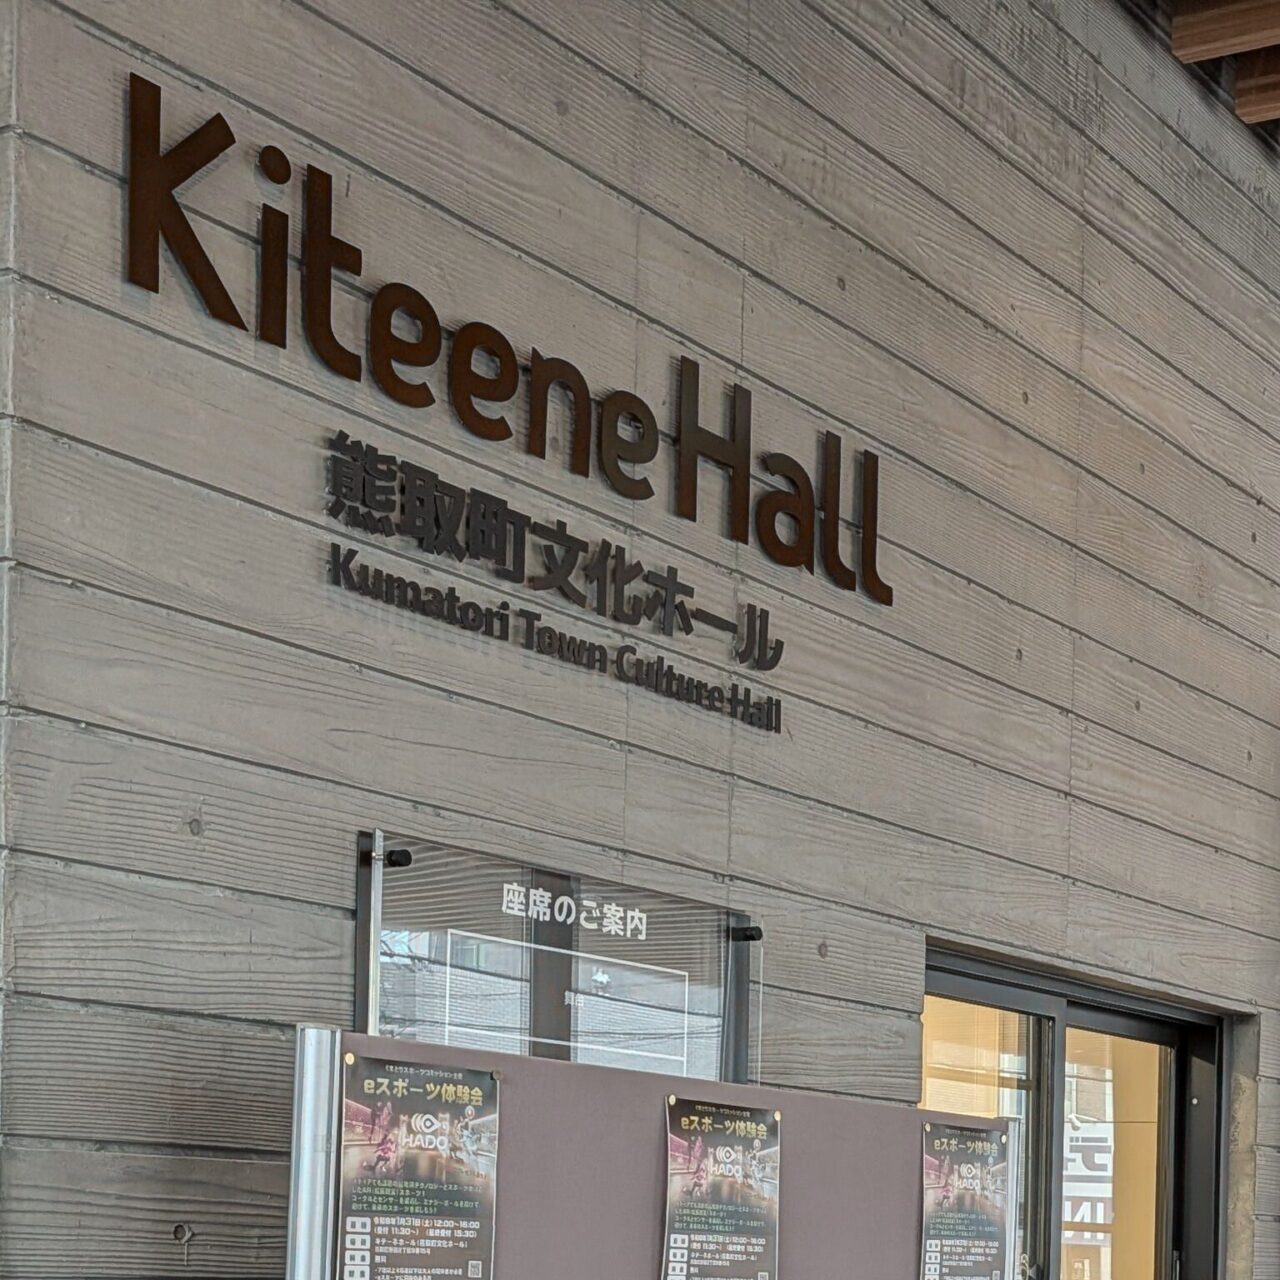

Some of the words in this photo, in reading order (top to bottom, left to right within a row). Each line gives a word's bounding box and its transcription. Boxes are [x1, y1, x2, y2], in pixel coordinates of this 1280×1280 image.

[127, 71, 660, 501] Kiteene
[677, 354, 894, 607] Hall
[330, 429, 784, 673] 熊取町文化ホール
[330, 542, 510, 642] Kumatori
[520, 610, 608, 675] Town
[616, 643, 725, 712] Culture
[729, 684, 783, 735] Hall
[502, 882, 648, 941] 座席のご案内
[364, 1077, 483, 1106] eスポーツ体験会
[400, 1134, 449, 1150] HADO
[680, 1116, 768, 1140] eスポーツ体験会
[710, 1164, 742, 1177] HADO
